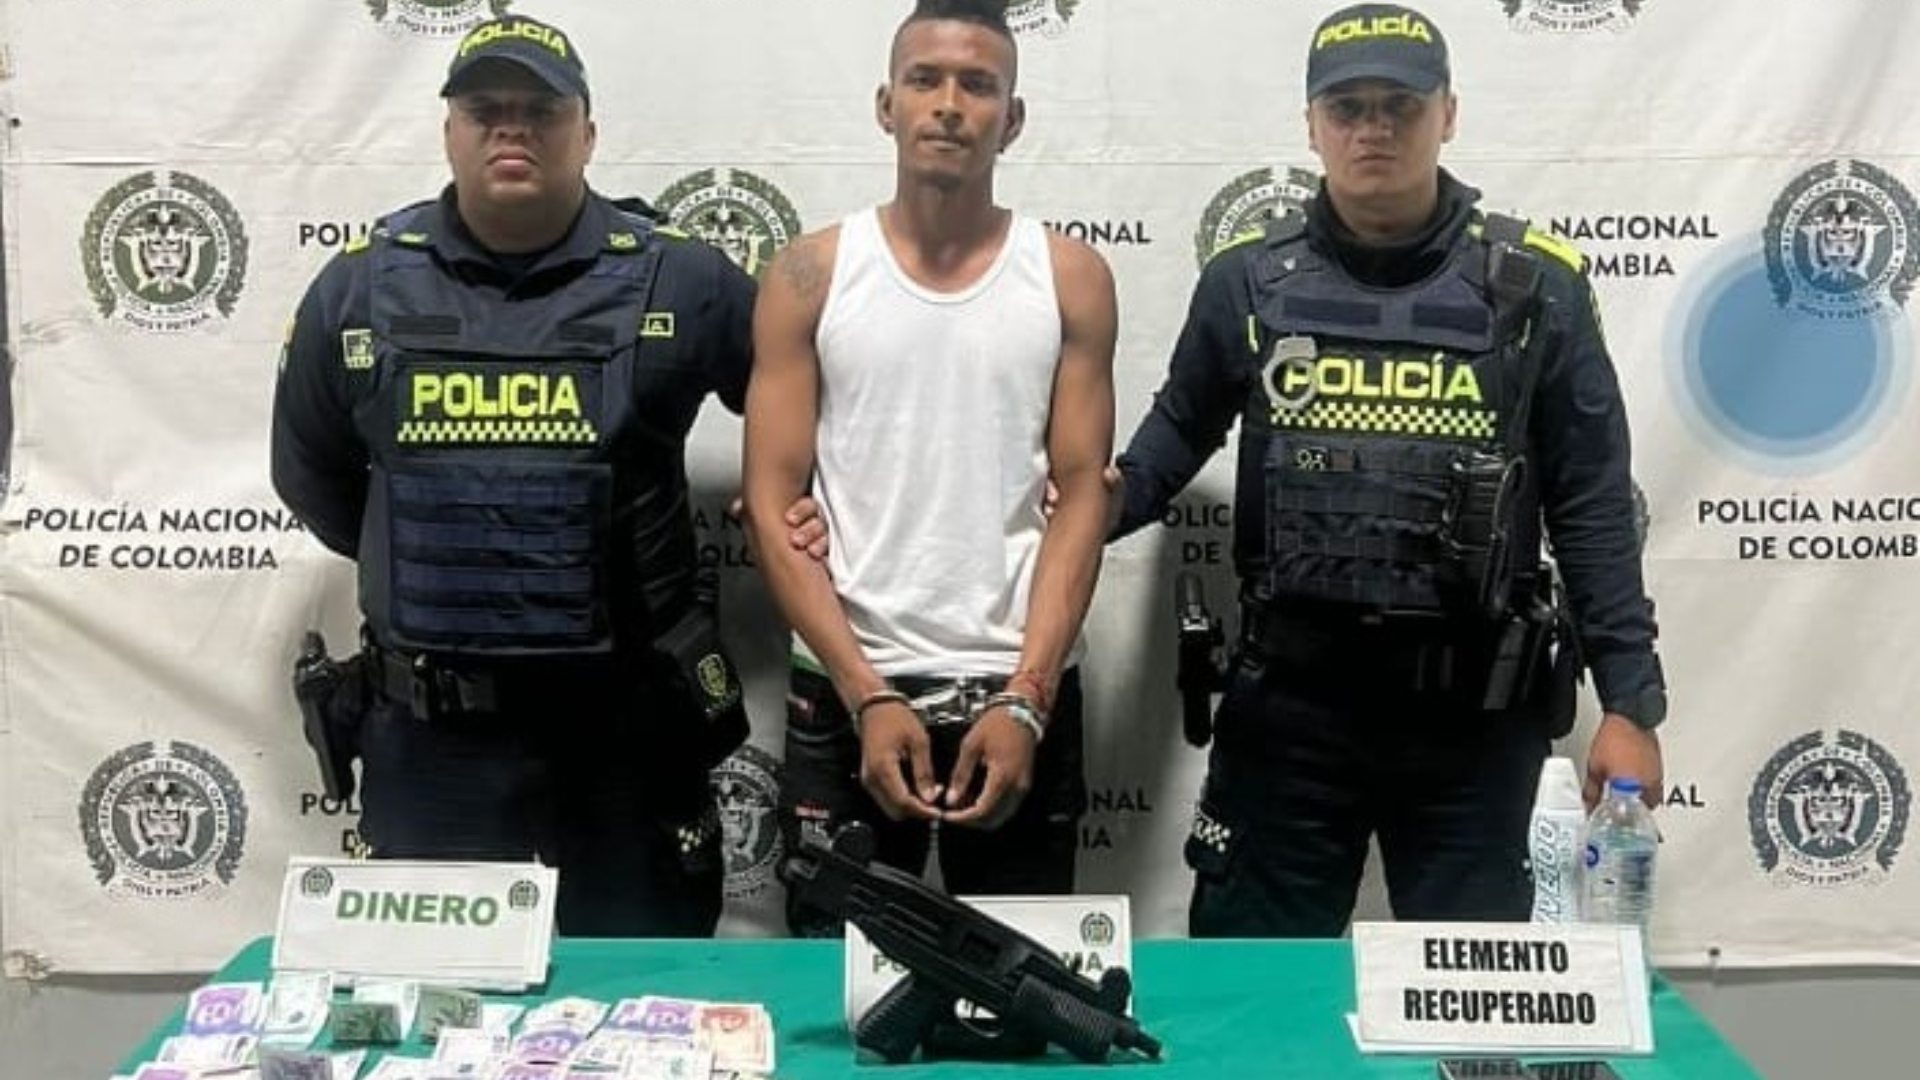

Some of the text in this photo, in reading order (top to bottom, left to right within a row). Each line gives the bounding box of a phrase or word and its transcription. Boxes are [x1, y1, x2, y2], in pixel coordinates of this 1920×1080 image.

[1316, 12, 1433, 50] POLICÍA
[1551, 214, 1719, 240] NACIONAL
[413, 373, 581, 417] POLICIA
[24, 501, 305, 532] POLICÍA NACIONA
[1163, 503, 1230, 528] OLIC
[1699, 492, 1920, 524] POLICÍA NACIO
[59, 544, 279, 570] DE COLOMBIA
[1183, 541, 1222, 564] DE
[1739, 533, 1919, 560] DE COLOMB
[336, 889, 499, 926] DINERO
[1423, 938, 1570, 974] ELEMENTO
[1403, 988, 1597, 1025] RECUPERADO
